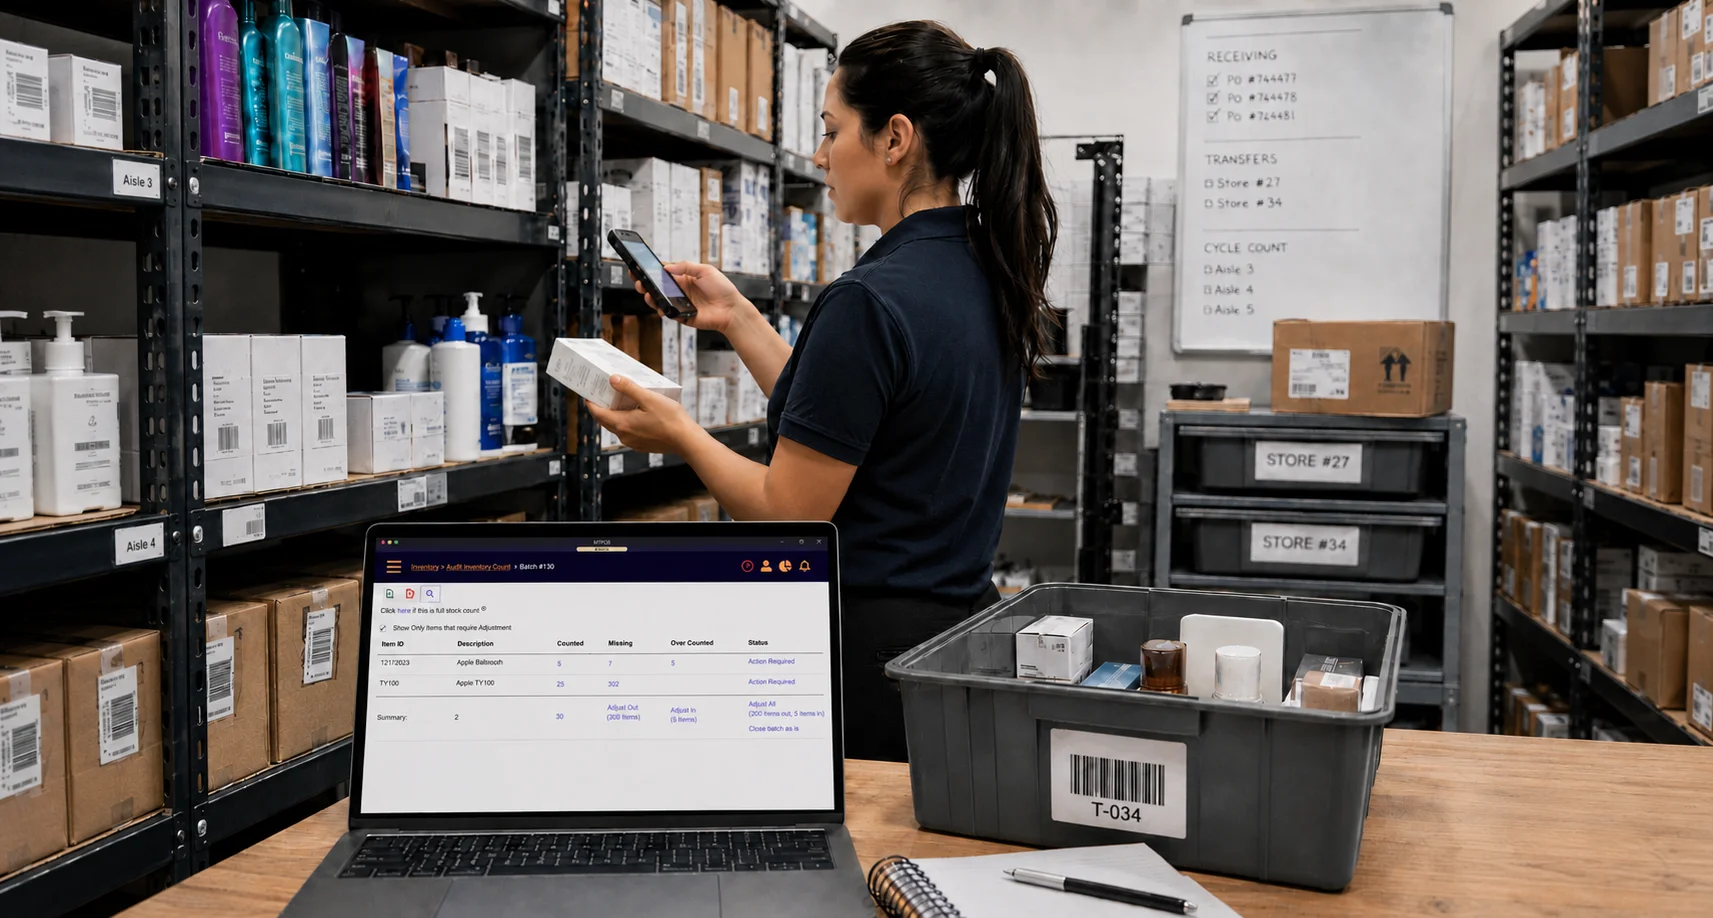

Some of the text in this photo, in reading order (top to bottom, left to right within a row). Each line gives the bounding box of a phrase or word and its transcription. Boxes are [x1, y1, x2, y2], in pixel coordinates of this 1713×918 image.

[1207, 50, 1278, 62] RECEIVING
[1204, 154, 1278, 165] TRANSFERS
[123, 174, 153, 188] Aisle 3
[1217, 178, 1249, 189] Store
[1217, 198, 1249, 209] Store
[1204, 242, 1288, 254] CYCLE COUNT
[1215, 263, 1254, 275] Aisle 3
[1215, 284, 1254, 295] Aisle 4
[1246, 304, 1254, 315] 5
[1267, 453, 1350, 469] STORE #27
[127, 538, 156, 552] Aisle 4
[1263, 535, 1347, 552] STORE #34
[1091, 802, 1141, 822] T-034
